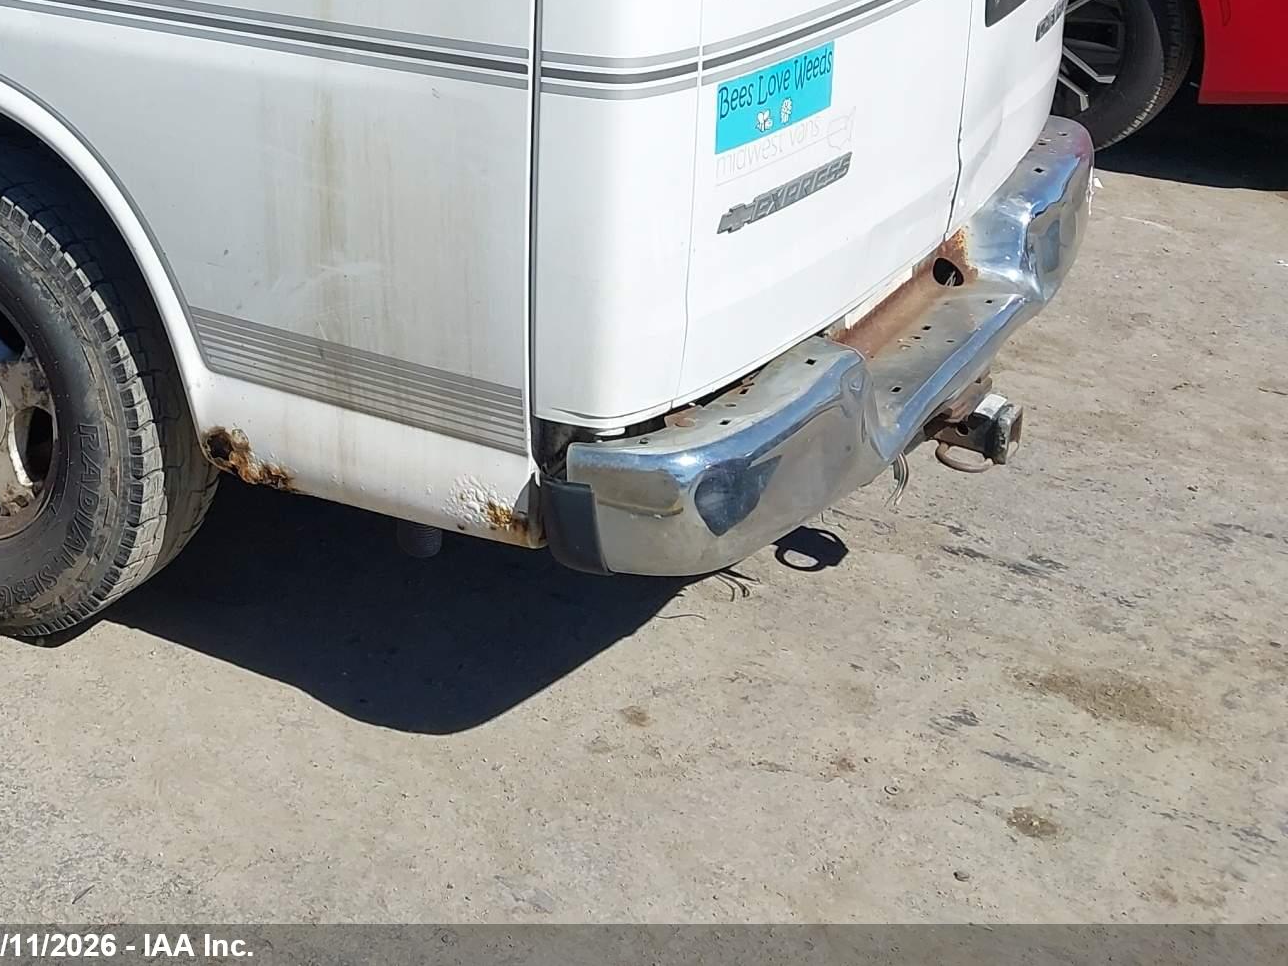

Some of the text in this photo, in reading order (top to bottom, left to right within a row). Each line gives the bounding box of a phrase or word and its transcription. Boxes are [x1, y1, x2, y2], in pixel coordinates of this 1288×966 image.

[718, 48, 833, 119] Bees Love Weeds
[751, 153, 852, 220] EXPRESS
[62, 423, 103, 568] RADIAL
